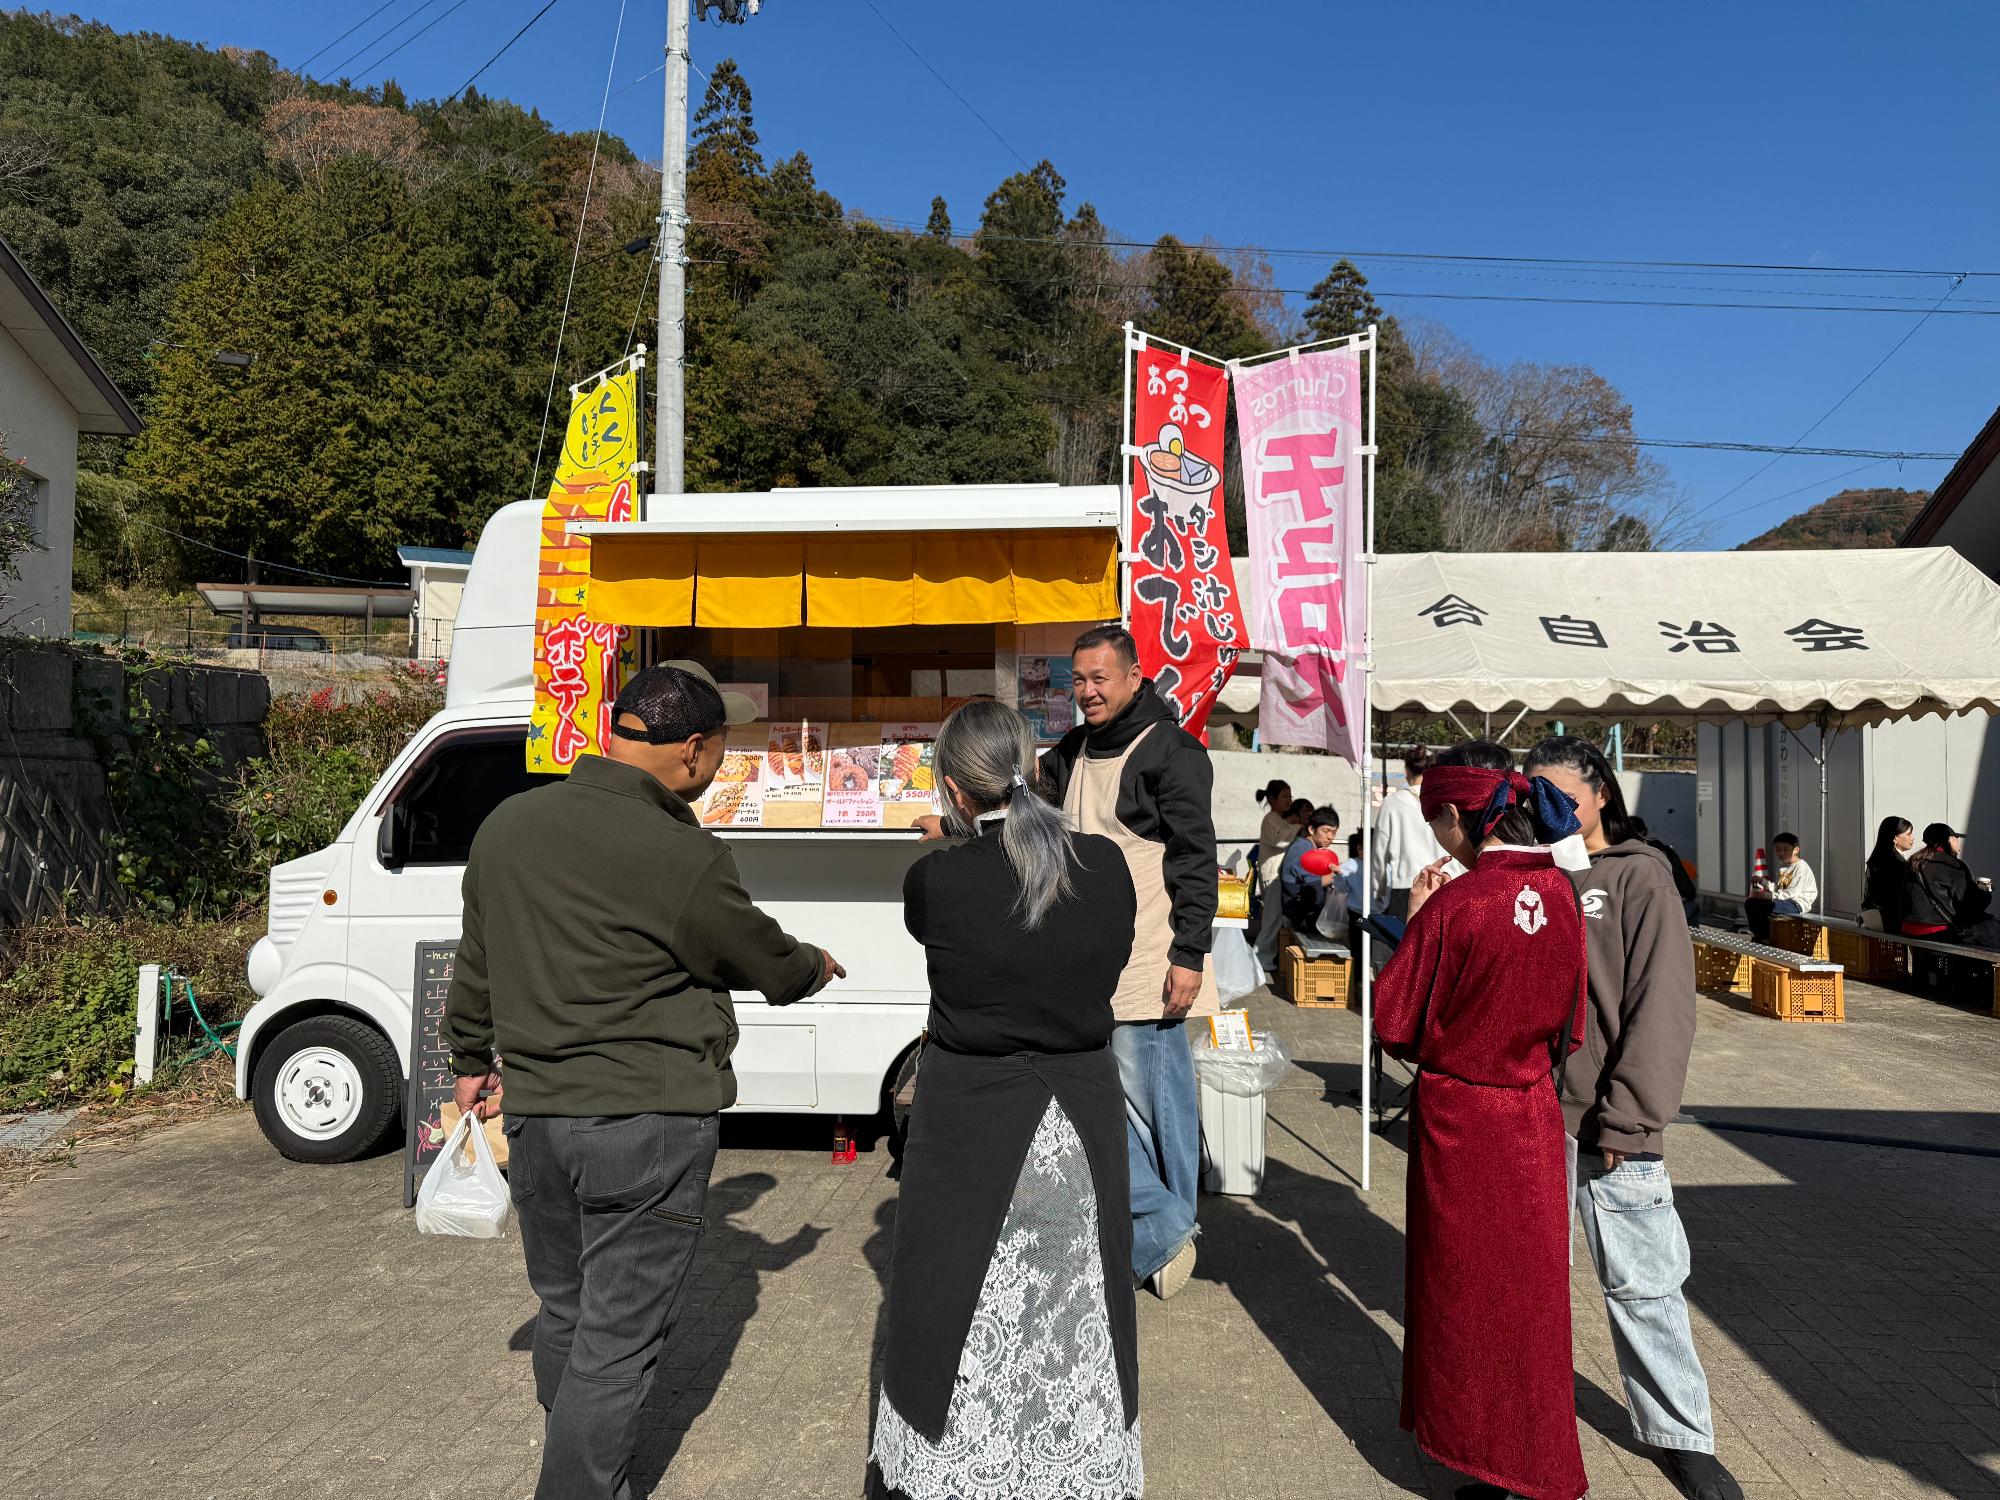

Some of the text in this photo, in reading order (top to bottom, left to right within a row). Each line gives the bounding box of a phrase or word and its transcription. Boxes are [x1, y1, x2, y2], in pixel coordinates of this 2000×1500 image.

[1135, 490, 1198, 722] おでん
[544, 613, 594, 766] ポテト
[905, 790, 930, 798] 550円
